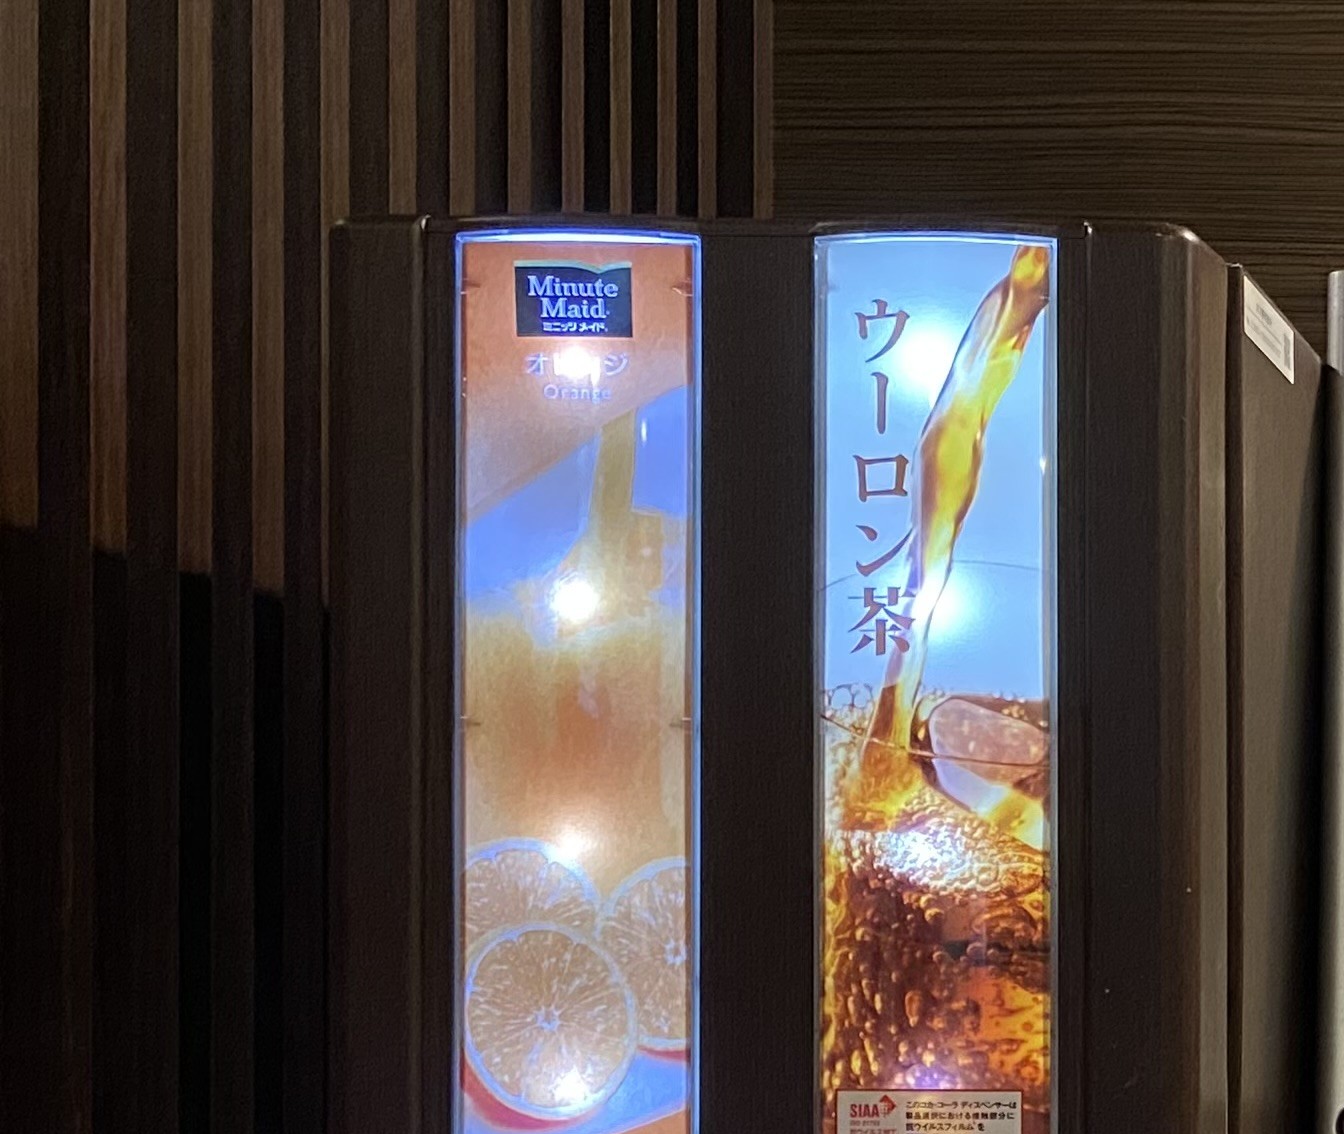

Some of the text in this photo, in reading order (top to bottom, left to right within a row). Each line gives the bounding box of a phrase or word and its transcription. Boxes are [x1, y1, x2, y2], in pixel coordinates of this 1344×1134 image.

[527, 275, 619, 298] Minute
[540, 298, 608, 318] Maid
[526, 352, 629, 376] オジ
[848, 298, 915, 656] ウーロン茶
[850, 1104, 880, 1118] SIAA
